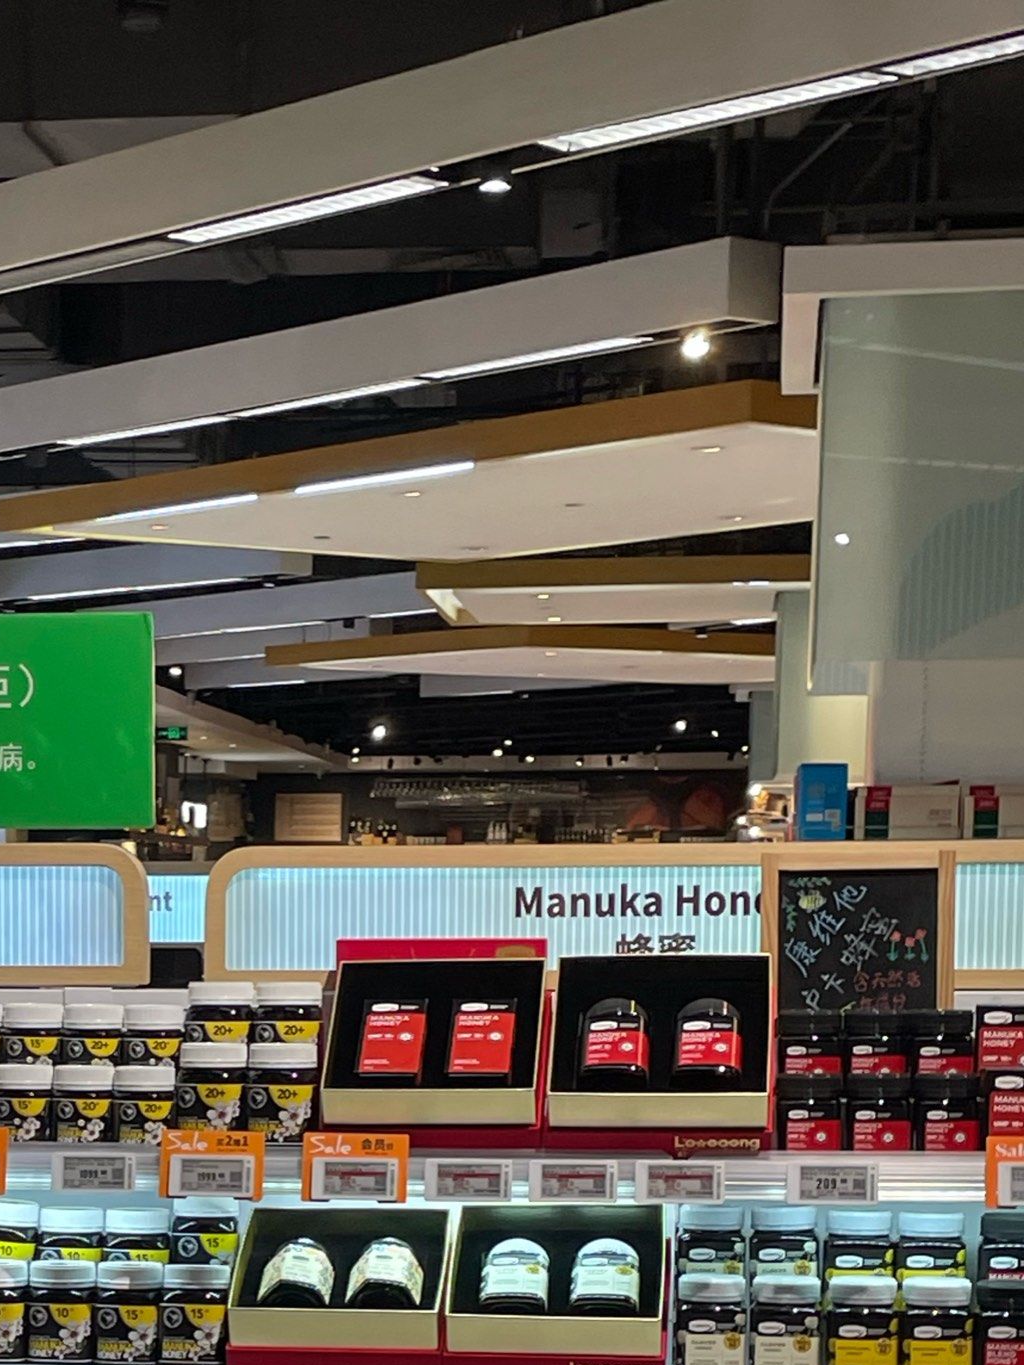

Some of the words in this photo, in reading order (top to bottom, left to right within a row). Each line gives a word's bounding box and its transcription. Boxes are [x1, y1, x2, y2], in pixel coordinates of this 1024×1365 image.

[515, 884, 662, 917] Manuka
[213, 1025, 233, 1035] 20+
[284, 1025, 304, 1035] 20+
[205, 1088, 226, 1098] 20+
[278, 1089, 298, 1099] 20+
[166, 1132, 208, 1151] Sale
[310, 1136, 351, 1154] Sale
[995, 1144, 1024, 1157] Sal
